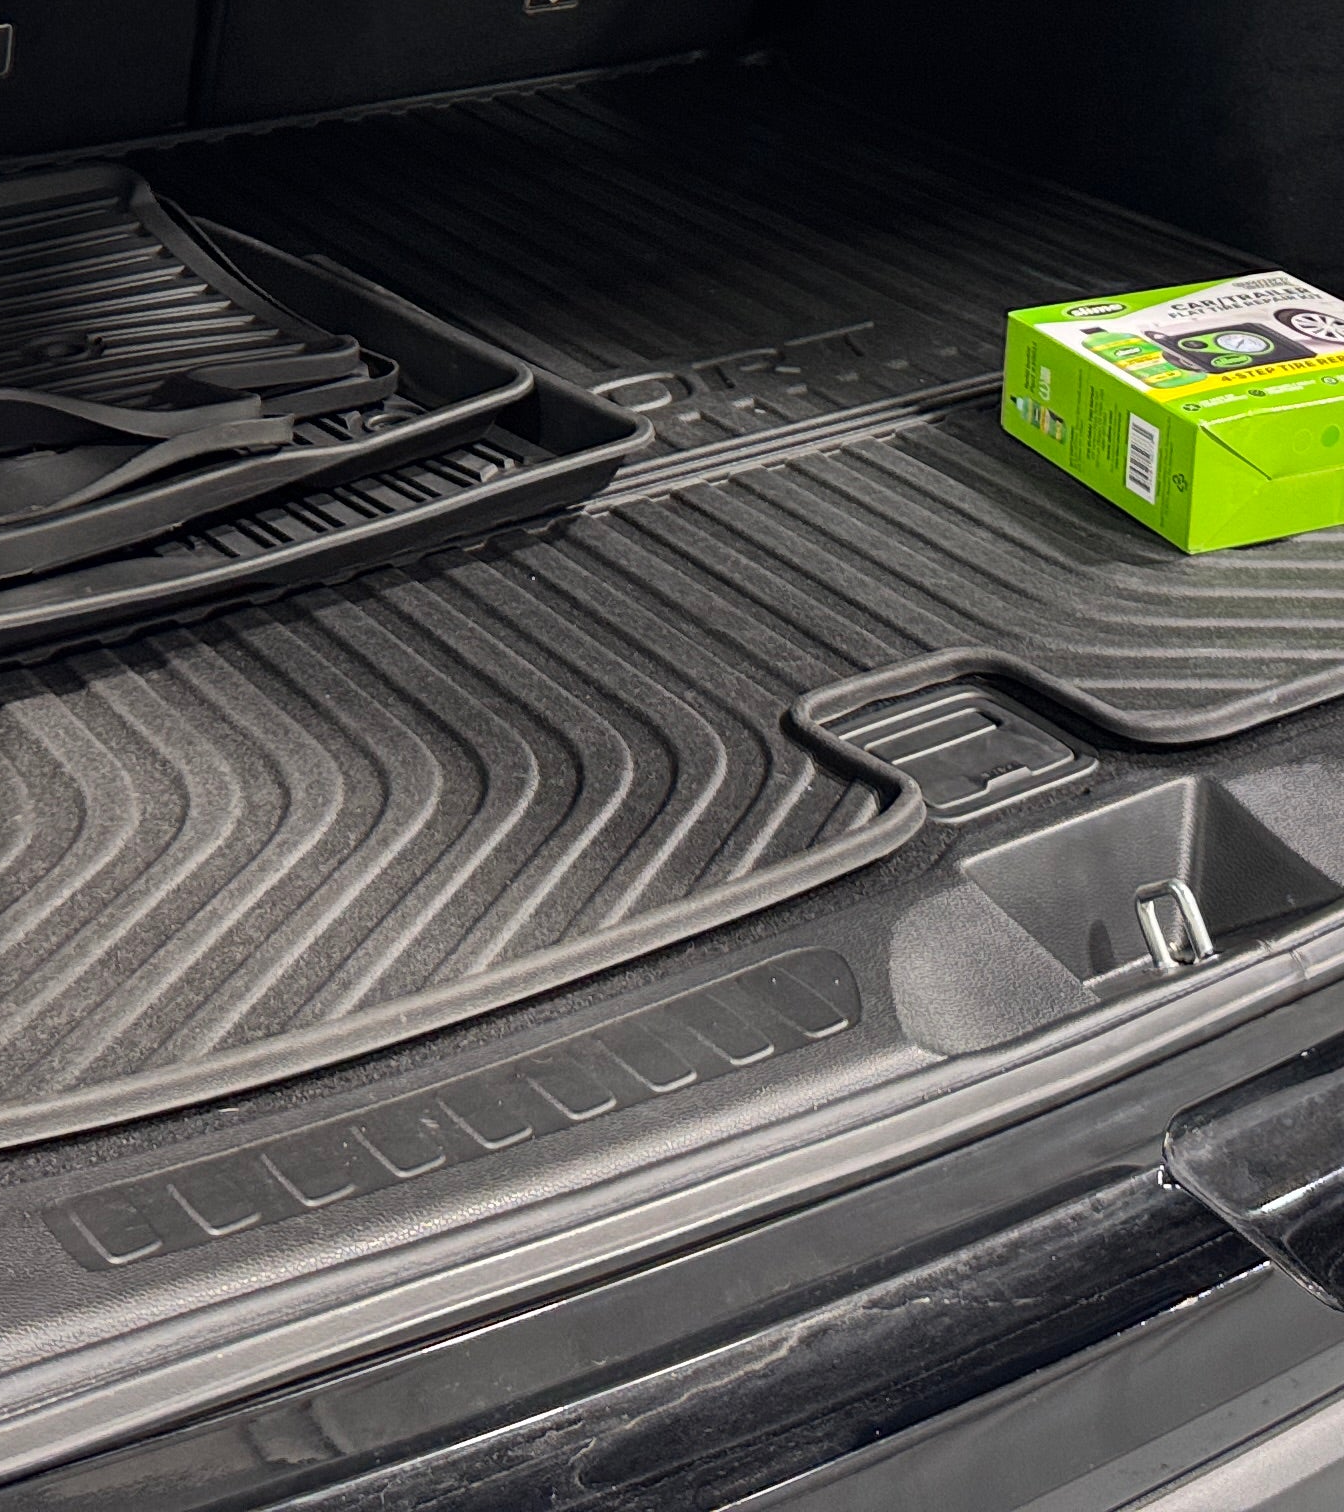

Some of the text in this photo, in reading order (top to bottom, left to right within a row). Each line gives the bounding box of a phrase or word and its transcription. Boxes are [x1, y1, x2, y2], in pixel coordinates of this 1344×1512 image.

[1168, 291, 1323, 319] FLAT TIRE REPAIR KIT
[1171, 287, 1311, 311] CAR/TRAILER
[1221, 366, 1274, 381] 4-STEP
[1278, 359, 1313, 372] TIRE
